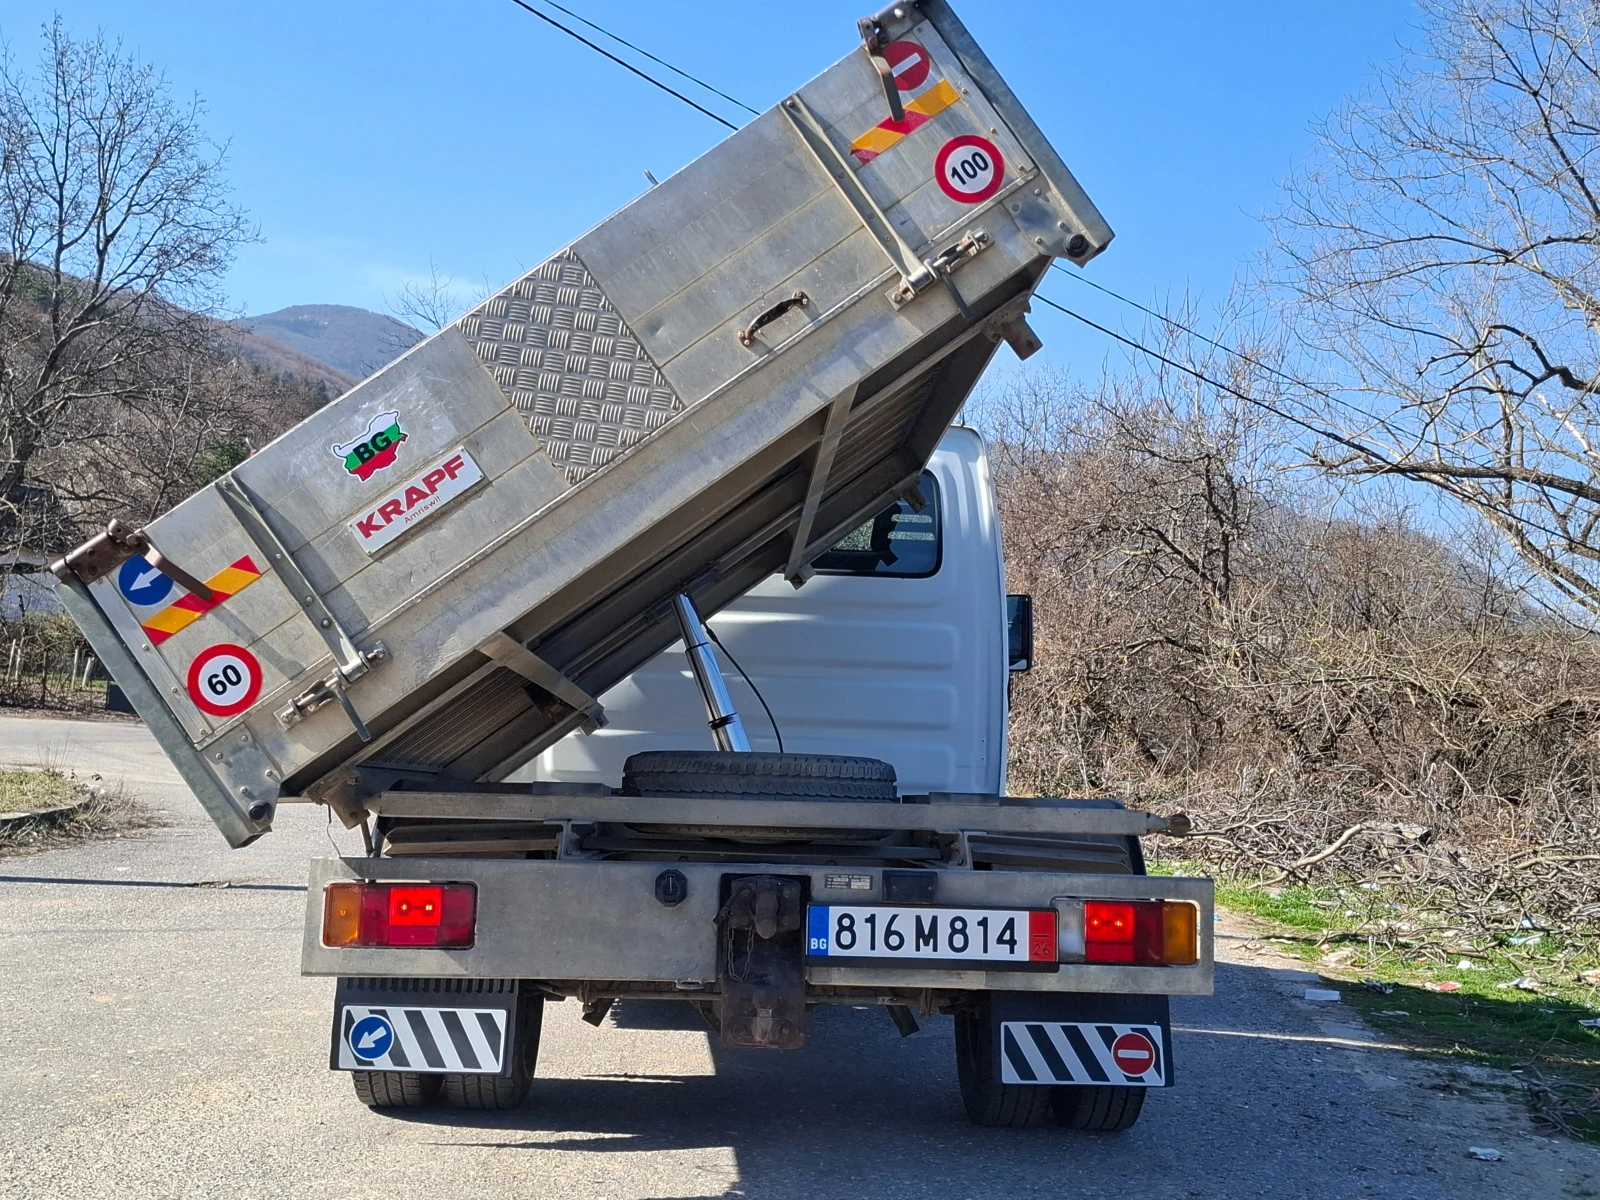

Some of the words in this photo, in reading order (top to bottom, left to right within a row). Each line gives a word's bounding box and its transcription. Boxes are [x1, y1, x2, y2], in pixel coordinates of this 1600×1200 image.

[951, 152, 989, 185] 100
[352, 431, 393, 464] BG
[356, 454, 465, 539] KRAPF
[404, 495, 441, 524] Amriswil
[207, 664, 242, 695] 60
[810, 938, 827, 949] BG
[1033, 943, 1050, 955] 26
